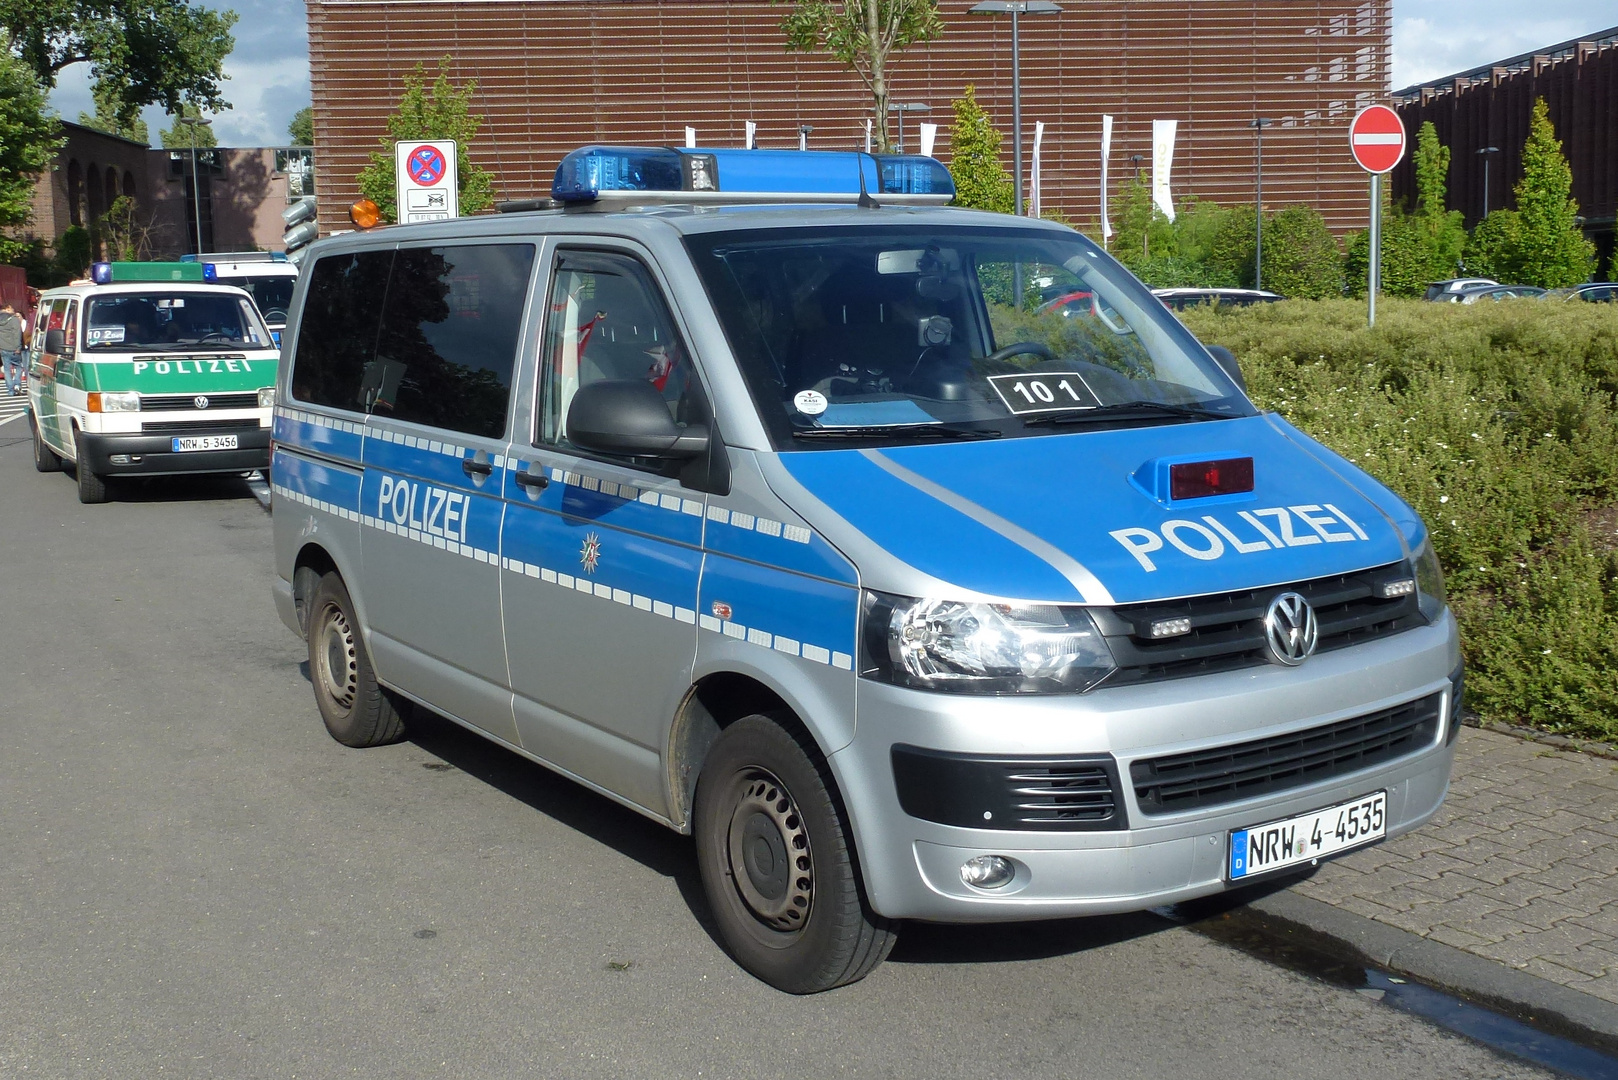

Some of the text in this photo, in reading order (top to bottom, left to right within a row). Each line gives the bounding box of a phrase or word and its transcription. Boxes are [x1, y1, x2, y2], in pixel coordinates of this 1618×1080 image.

[133, 361, 252, 375] POLIZEI
[1013, 380, 1081, 403] 10 1
[179, 437, 237, 449] NRW 5-3456
[378, 475, 471, 543] POLIZEI
[1108, 503, 1370, 573] POLIZEI
[1249, 798, 1383, 868] NRW 4-4535
[1235, 858, 1243, 869] D
